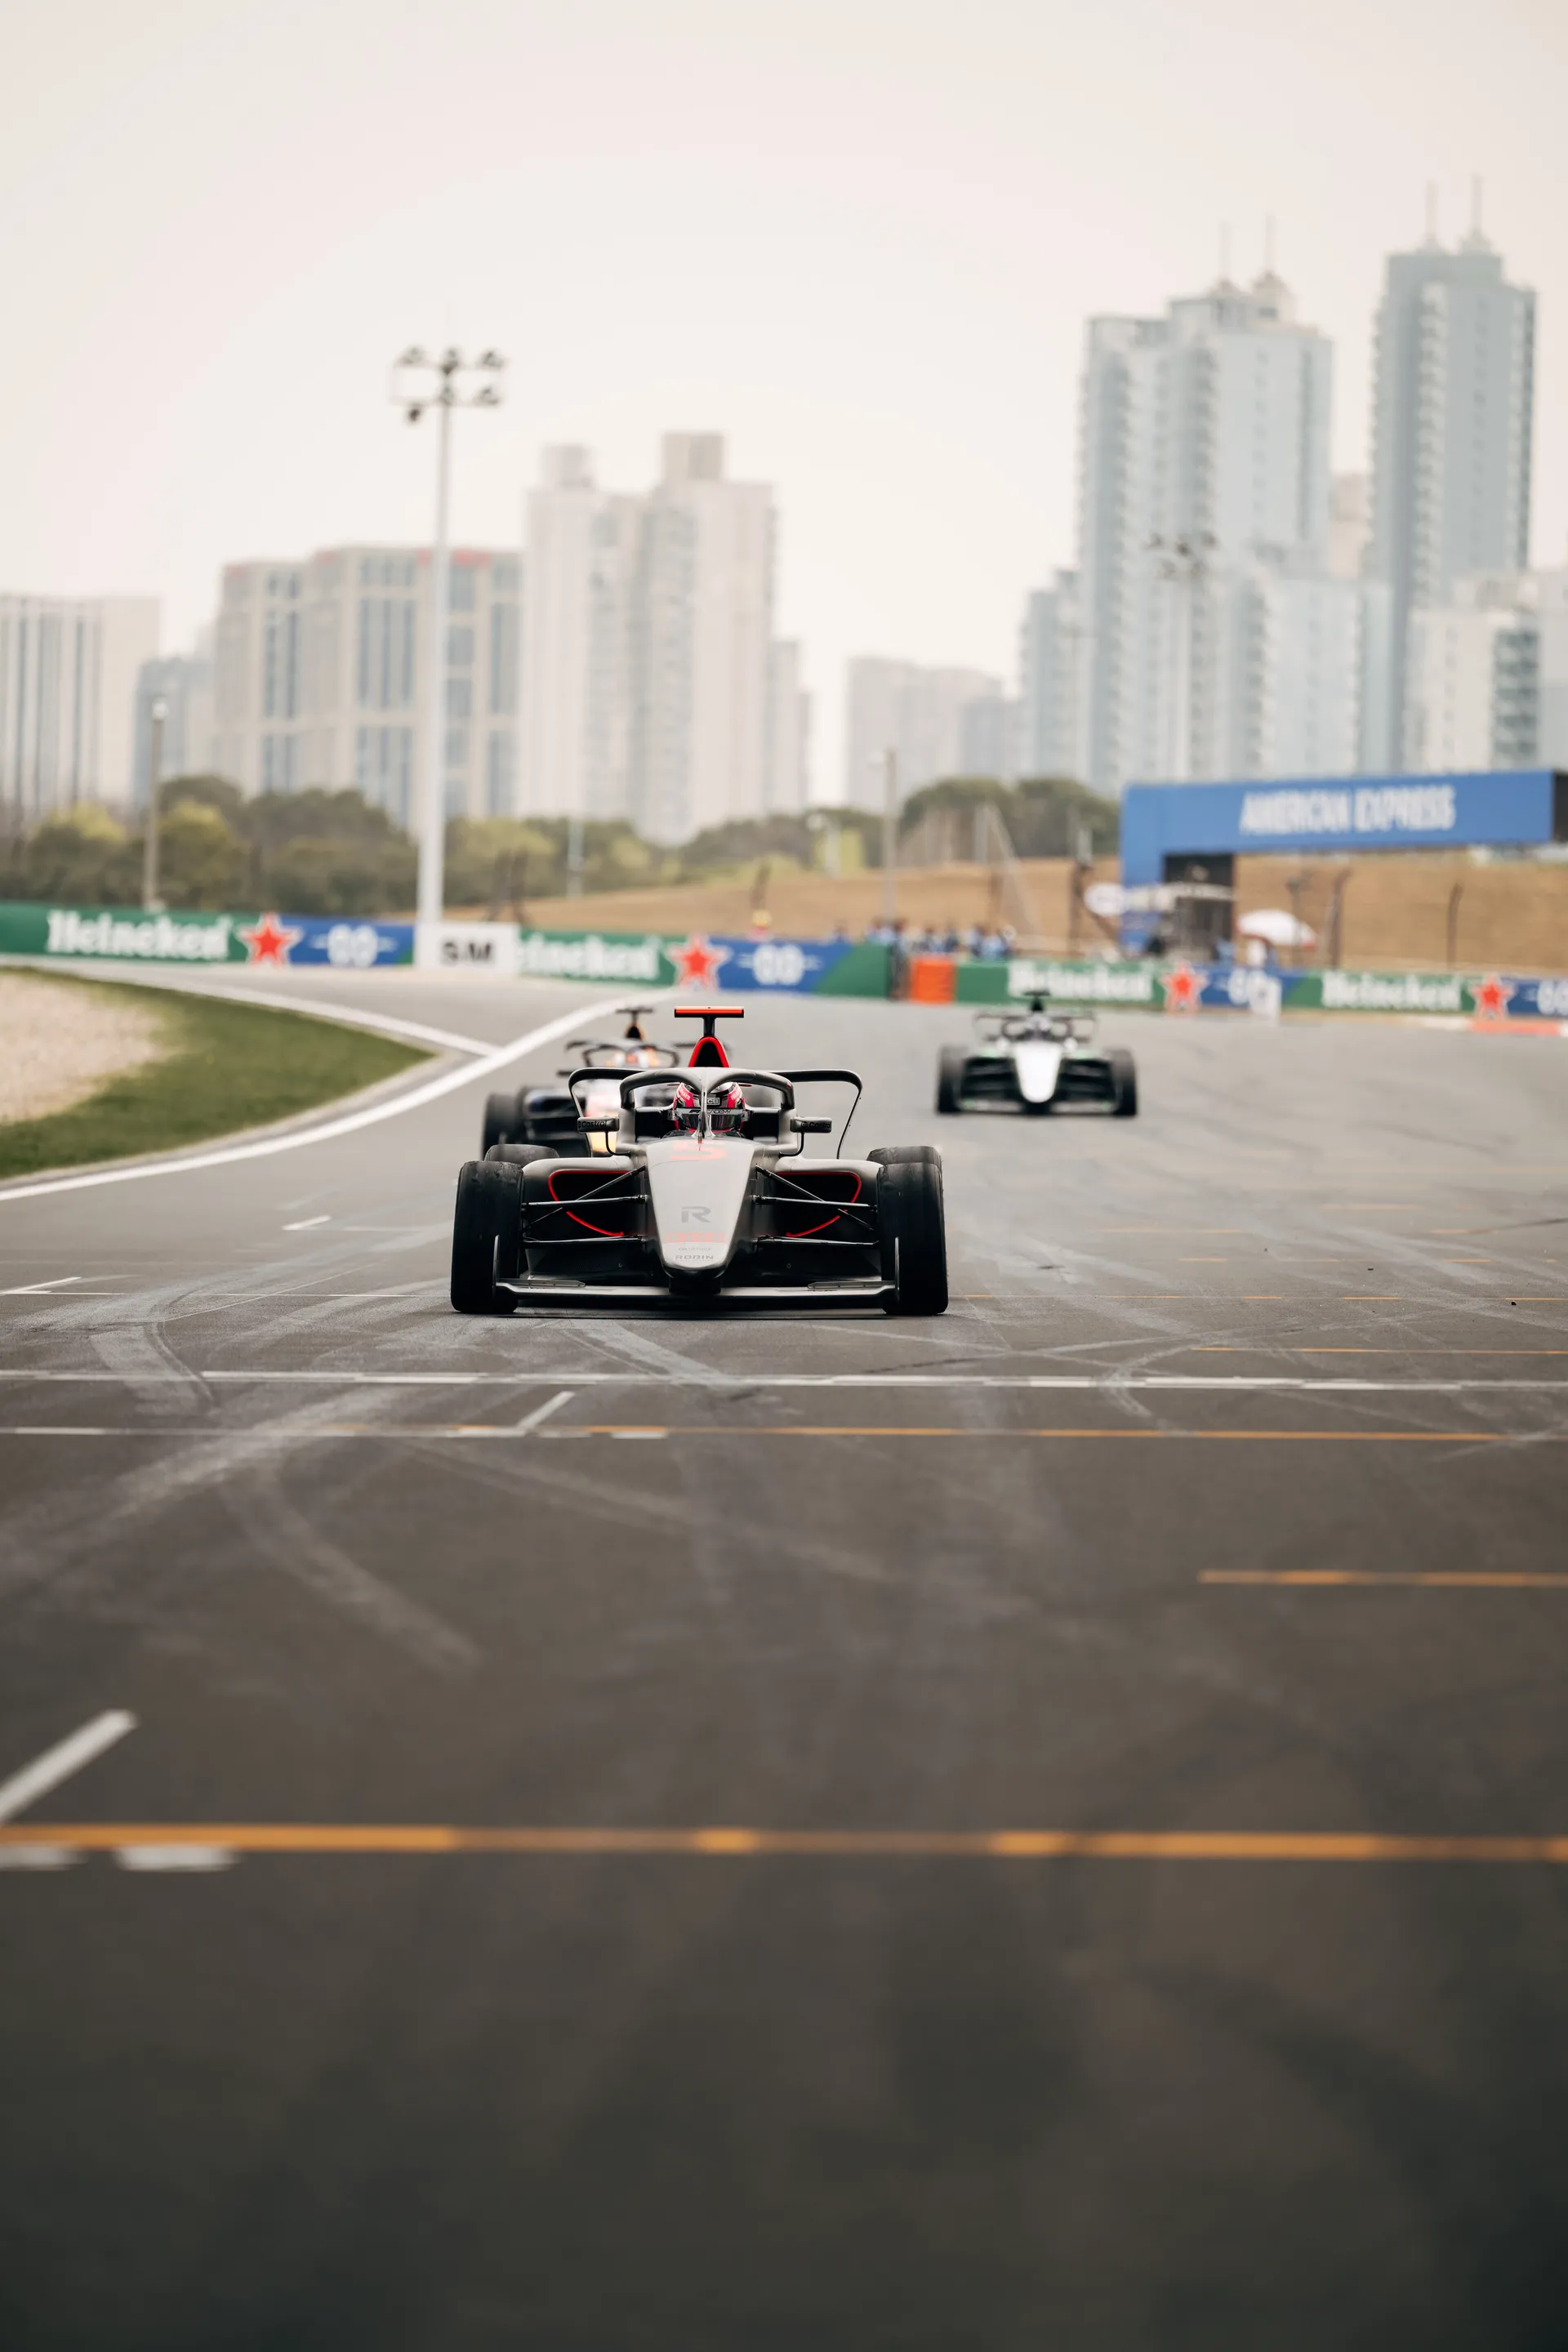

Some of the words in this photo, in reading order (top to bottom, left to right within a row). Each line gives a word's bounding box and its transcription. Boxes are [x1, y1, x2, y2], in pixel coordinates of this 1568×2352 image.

[1240, 789, 1348, 834] AMERICAN
[1355, 786, 1456, 831] EXPRESS
[48, 910, 231, 959] Heineken
[1321, 971, 1461, 1009] Heineken
[681, 1206, 711, 1223] R
